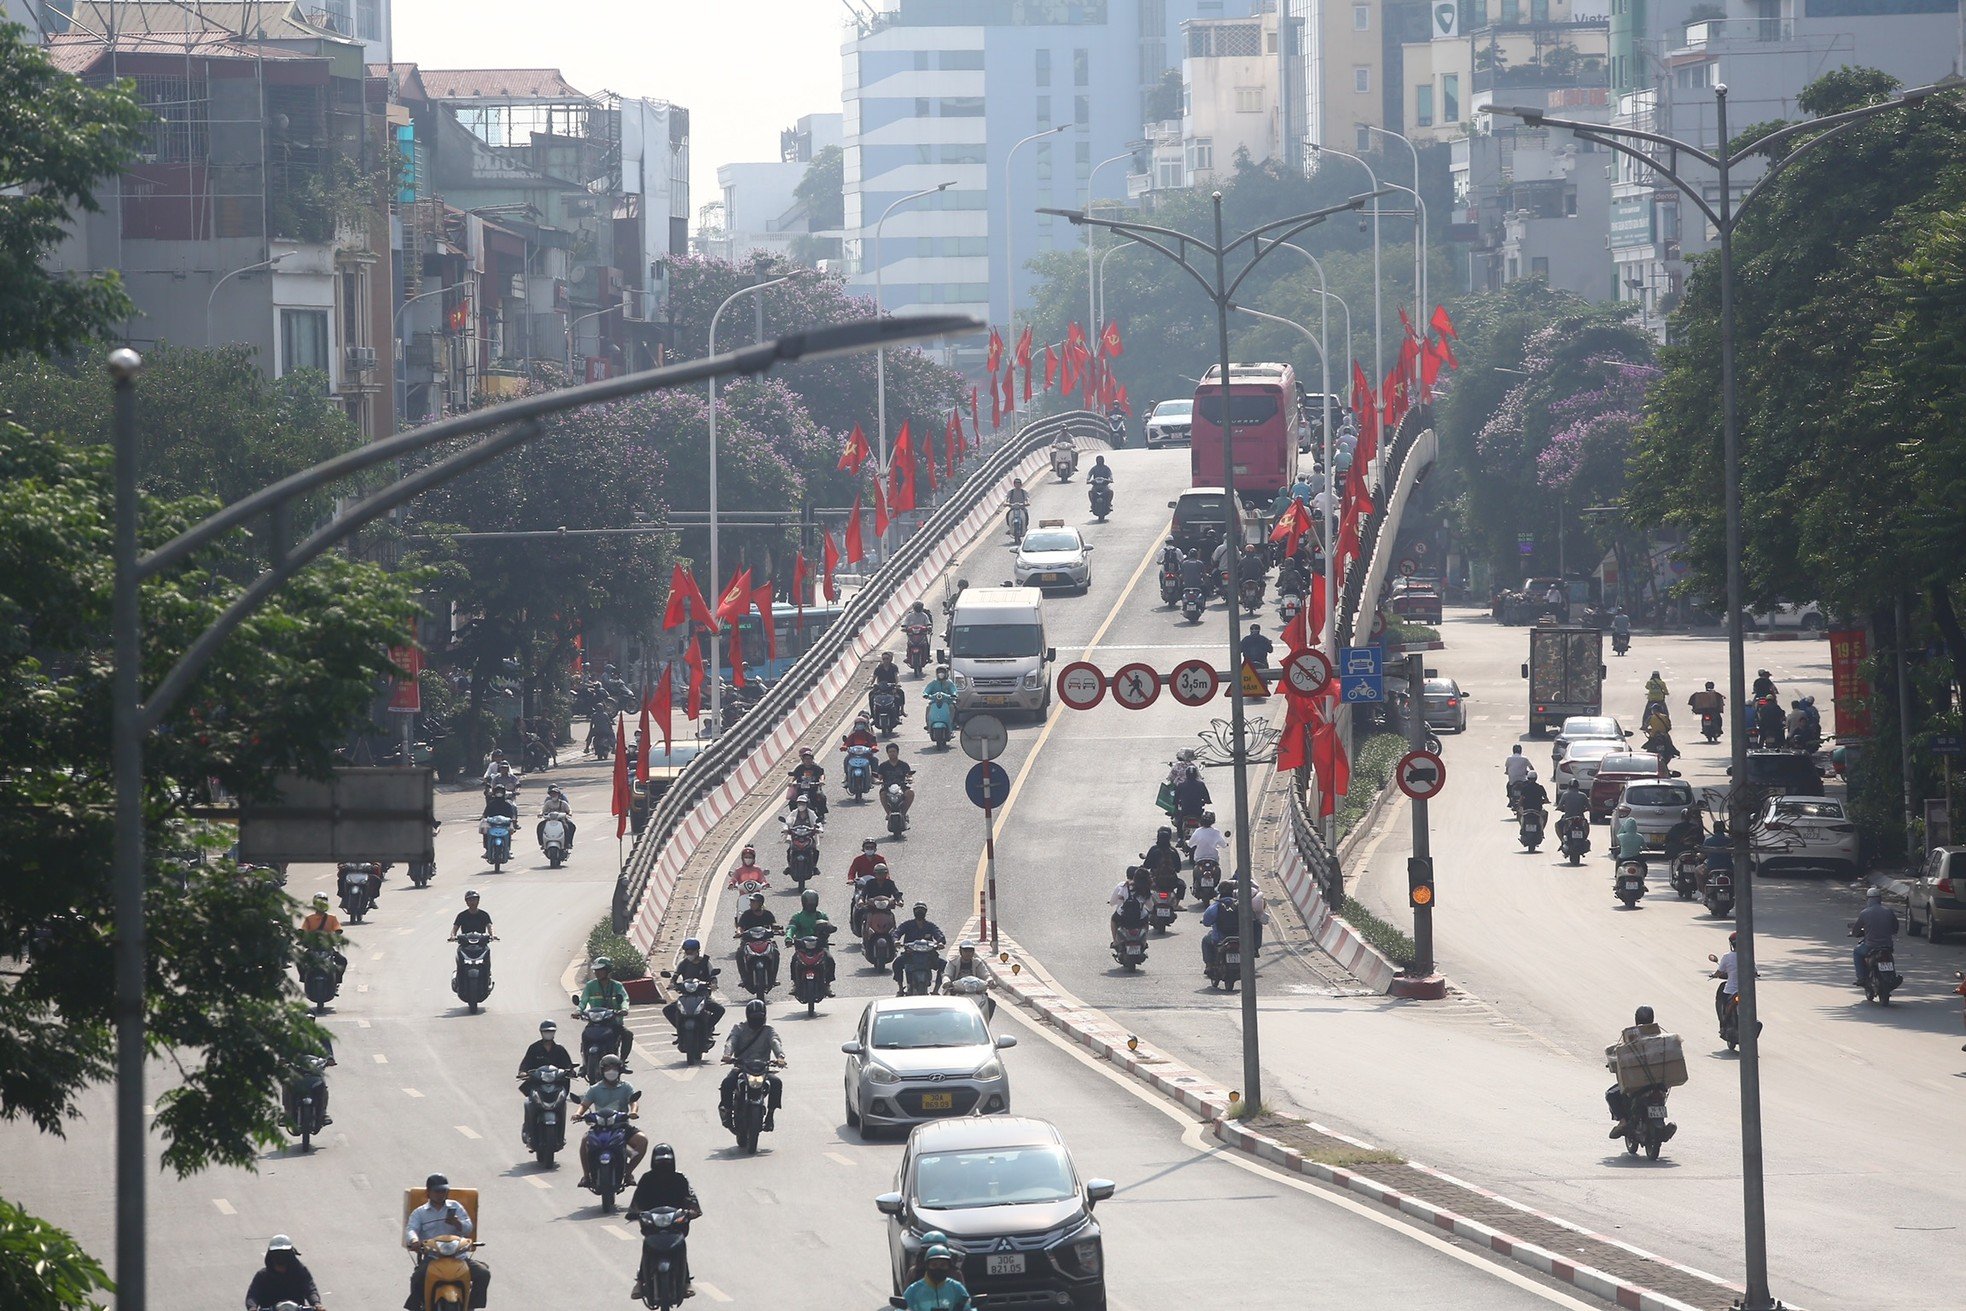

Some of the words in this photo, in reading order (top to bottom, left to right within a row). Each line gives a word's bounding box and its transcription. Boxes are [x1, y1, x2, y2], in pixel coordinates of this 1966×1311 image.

[1182, 673, 1208, 692] 3,5m
[997, 1256, 1014, 1264] 30G
[991, 1264, 1022, 1273] 821.05
